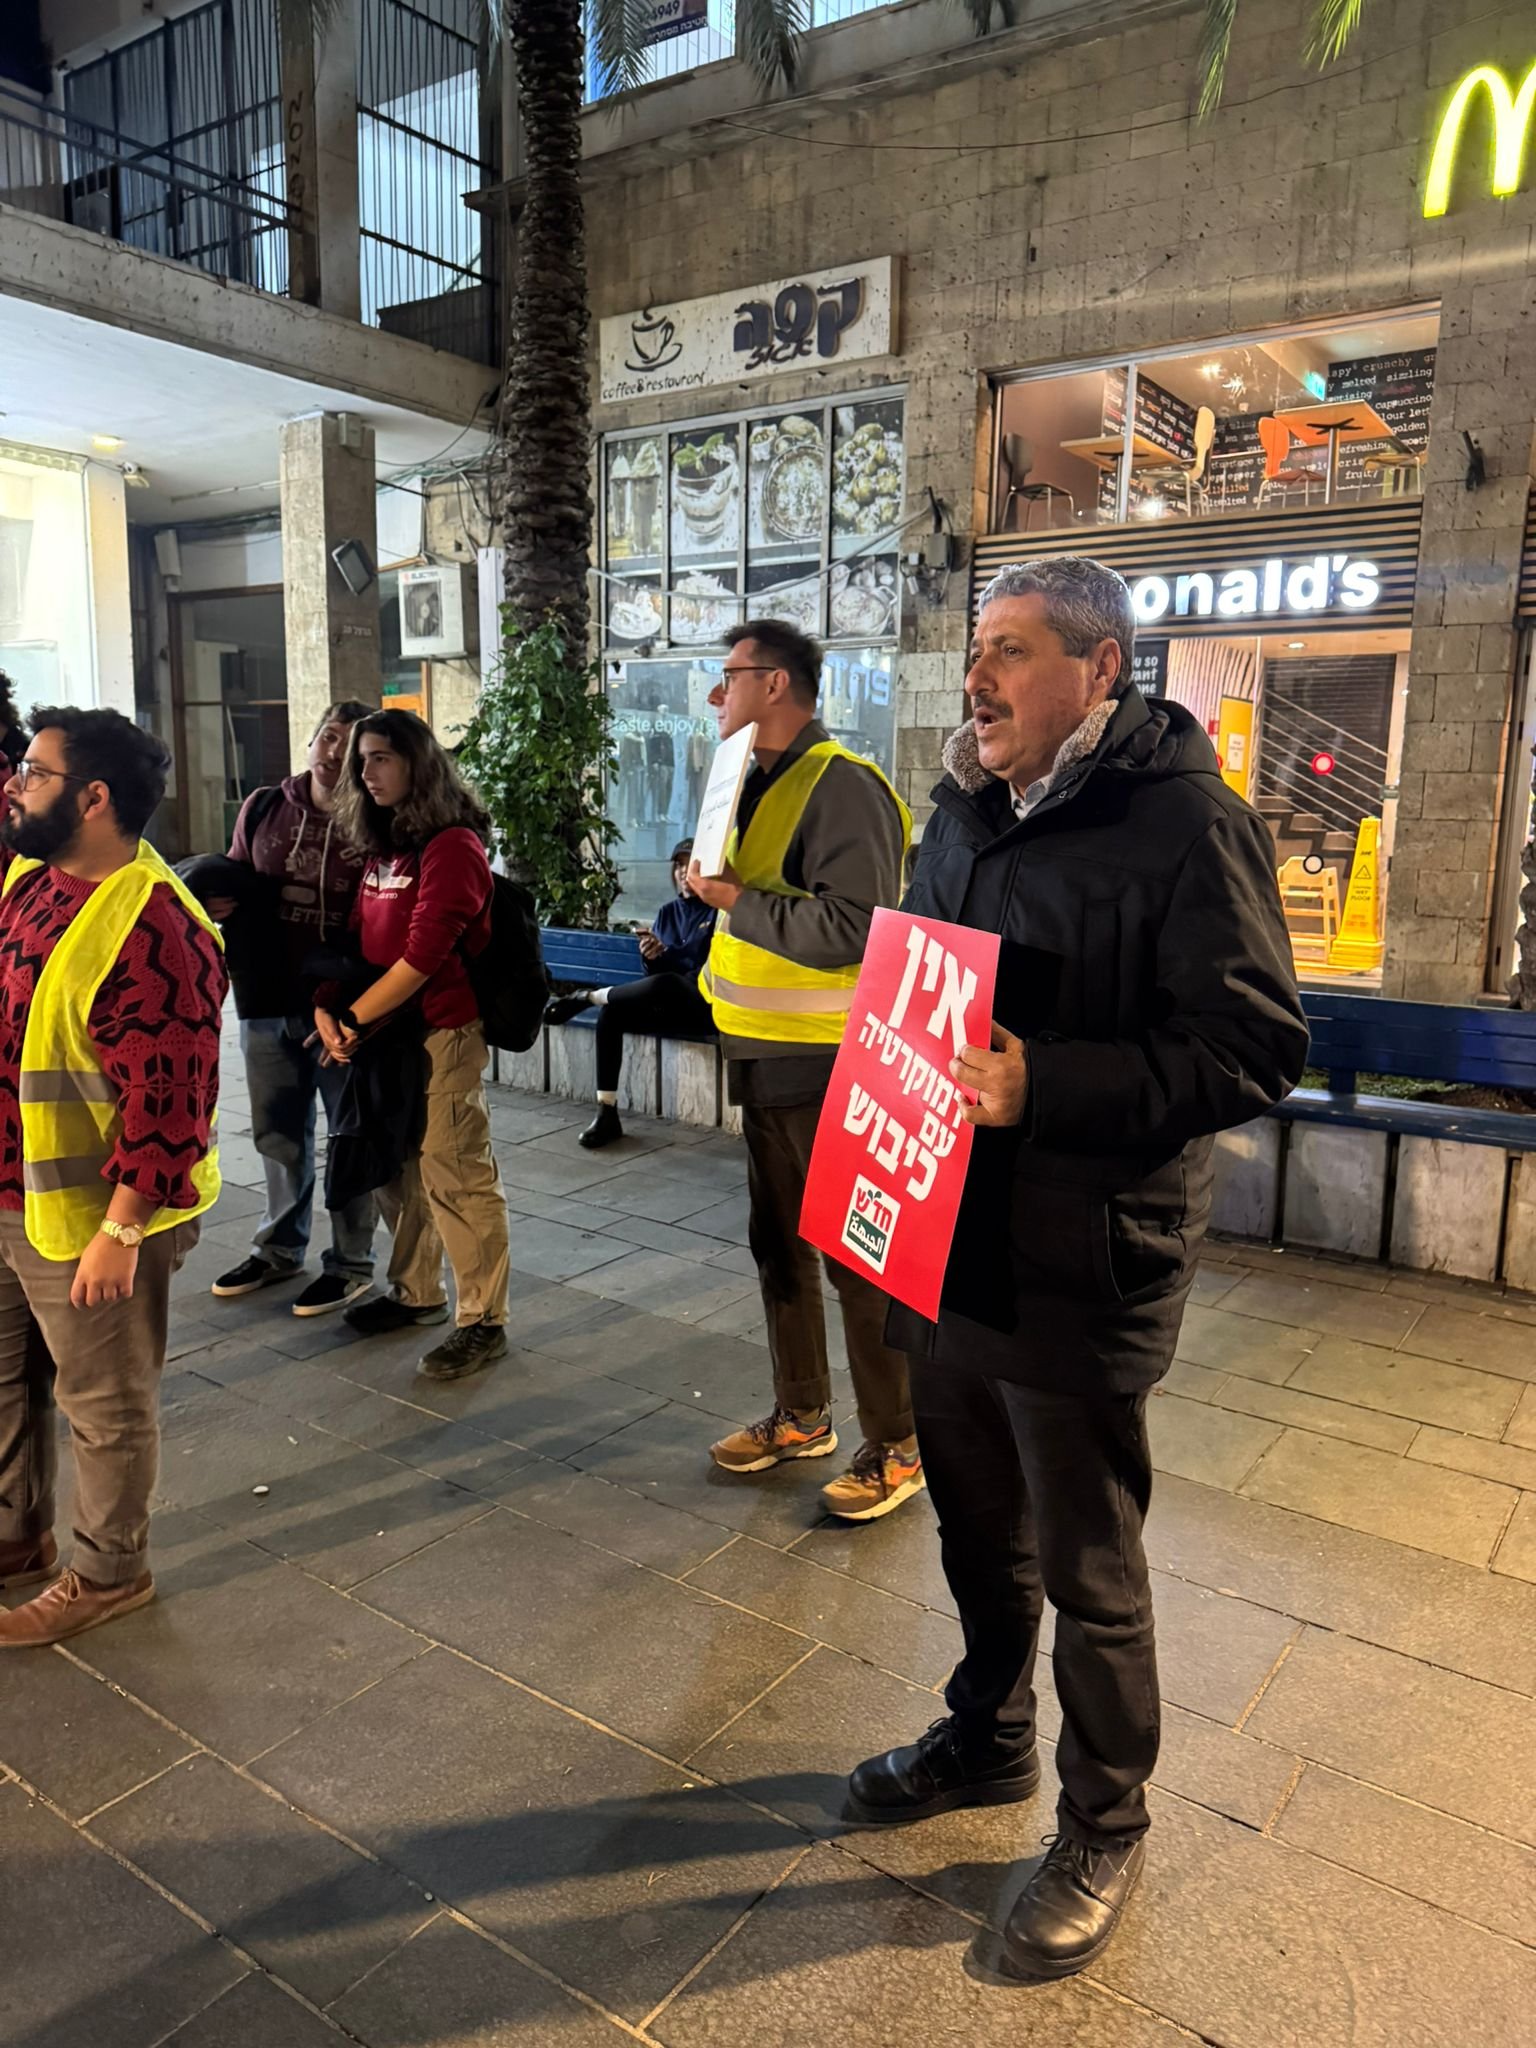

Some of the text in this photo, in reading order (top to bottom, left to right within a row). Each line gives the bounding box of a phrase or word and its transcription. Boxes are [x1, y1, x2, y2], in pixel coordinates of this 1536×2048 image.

[733, 277, 864, 358] קפה
[1328, 367, 1352, 378] spy
[1362, 357, 1412, 372] crunchy
[1341, 375, 1377, 389] melted
[1386, 368, 1433, 382] sizzling
[1132, 555, 1380, 622] onald's
[1133, 667, 1158, 681] ant
[1144, 656, 1159, 668] so
[888, 924, 978, 1058] אין
[843, 1081, 939, 1202] כיבוש
[918, 1109, 957, 1158] עם
[848, 1214, 886, 1255] الجبهة
